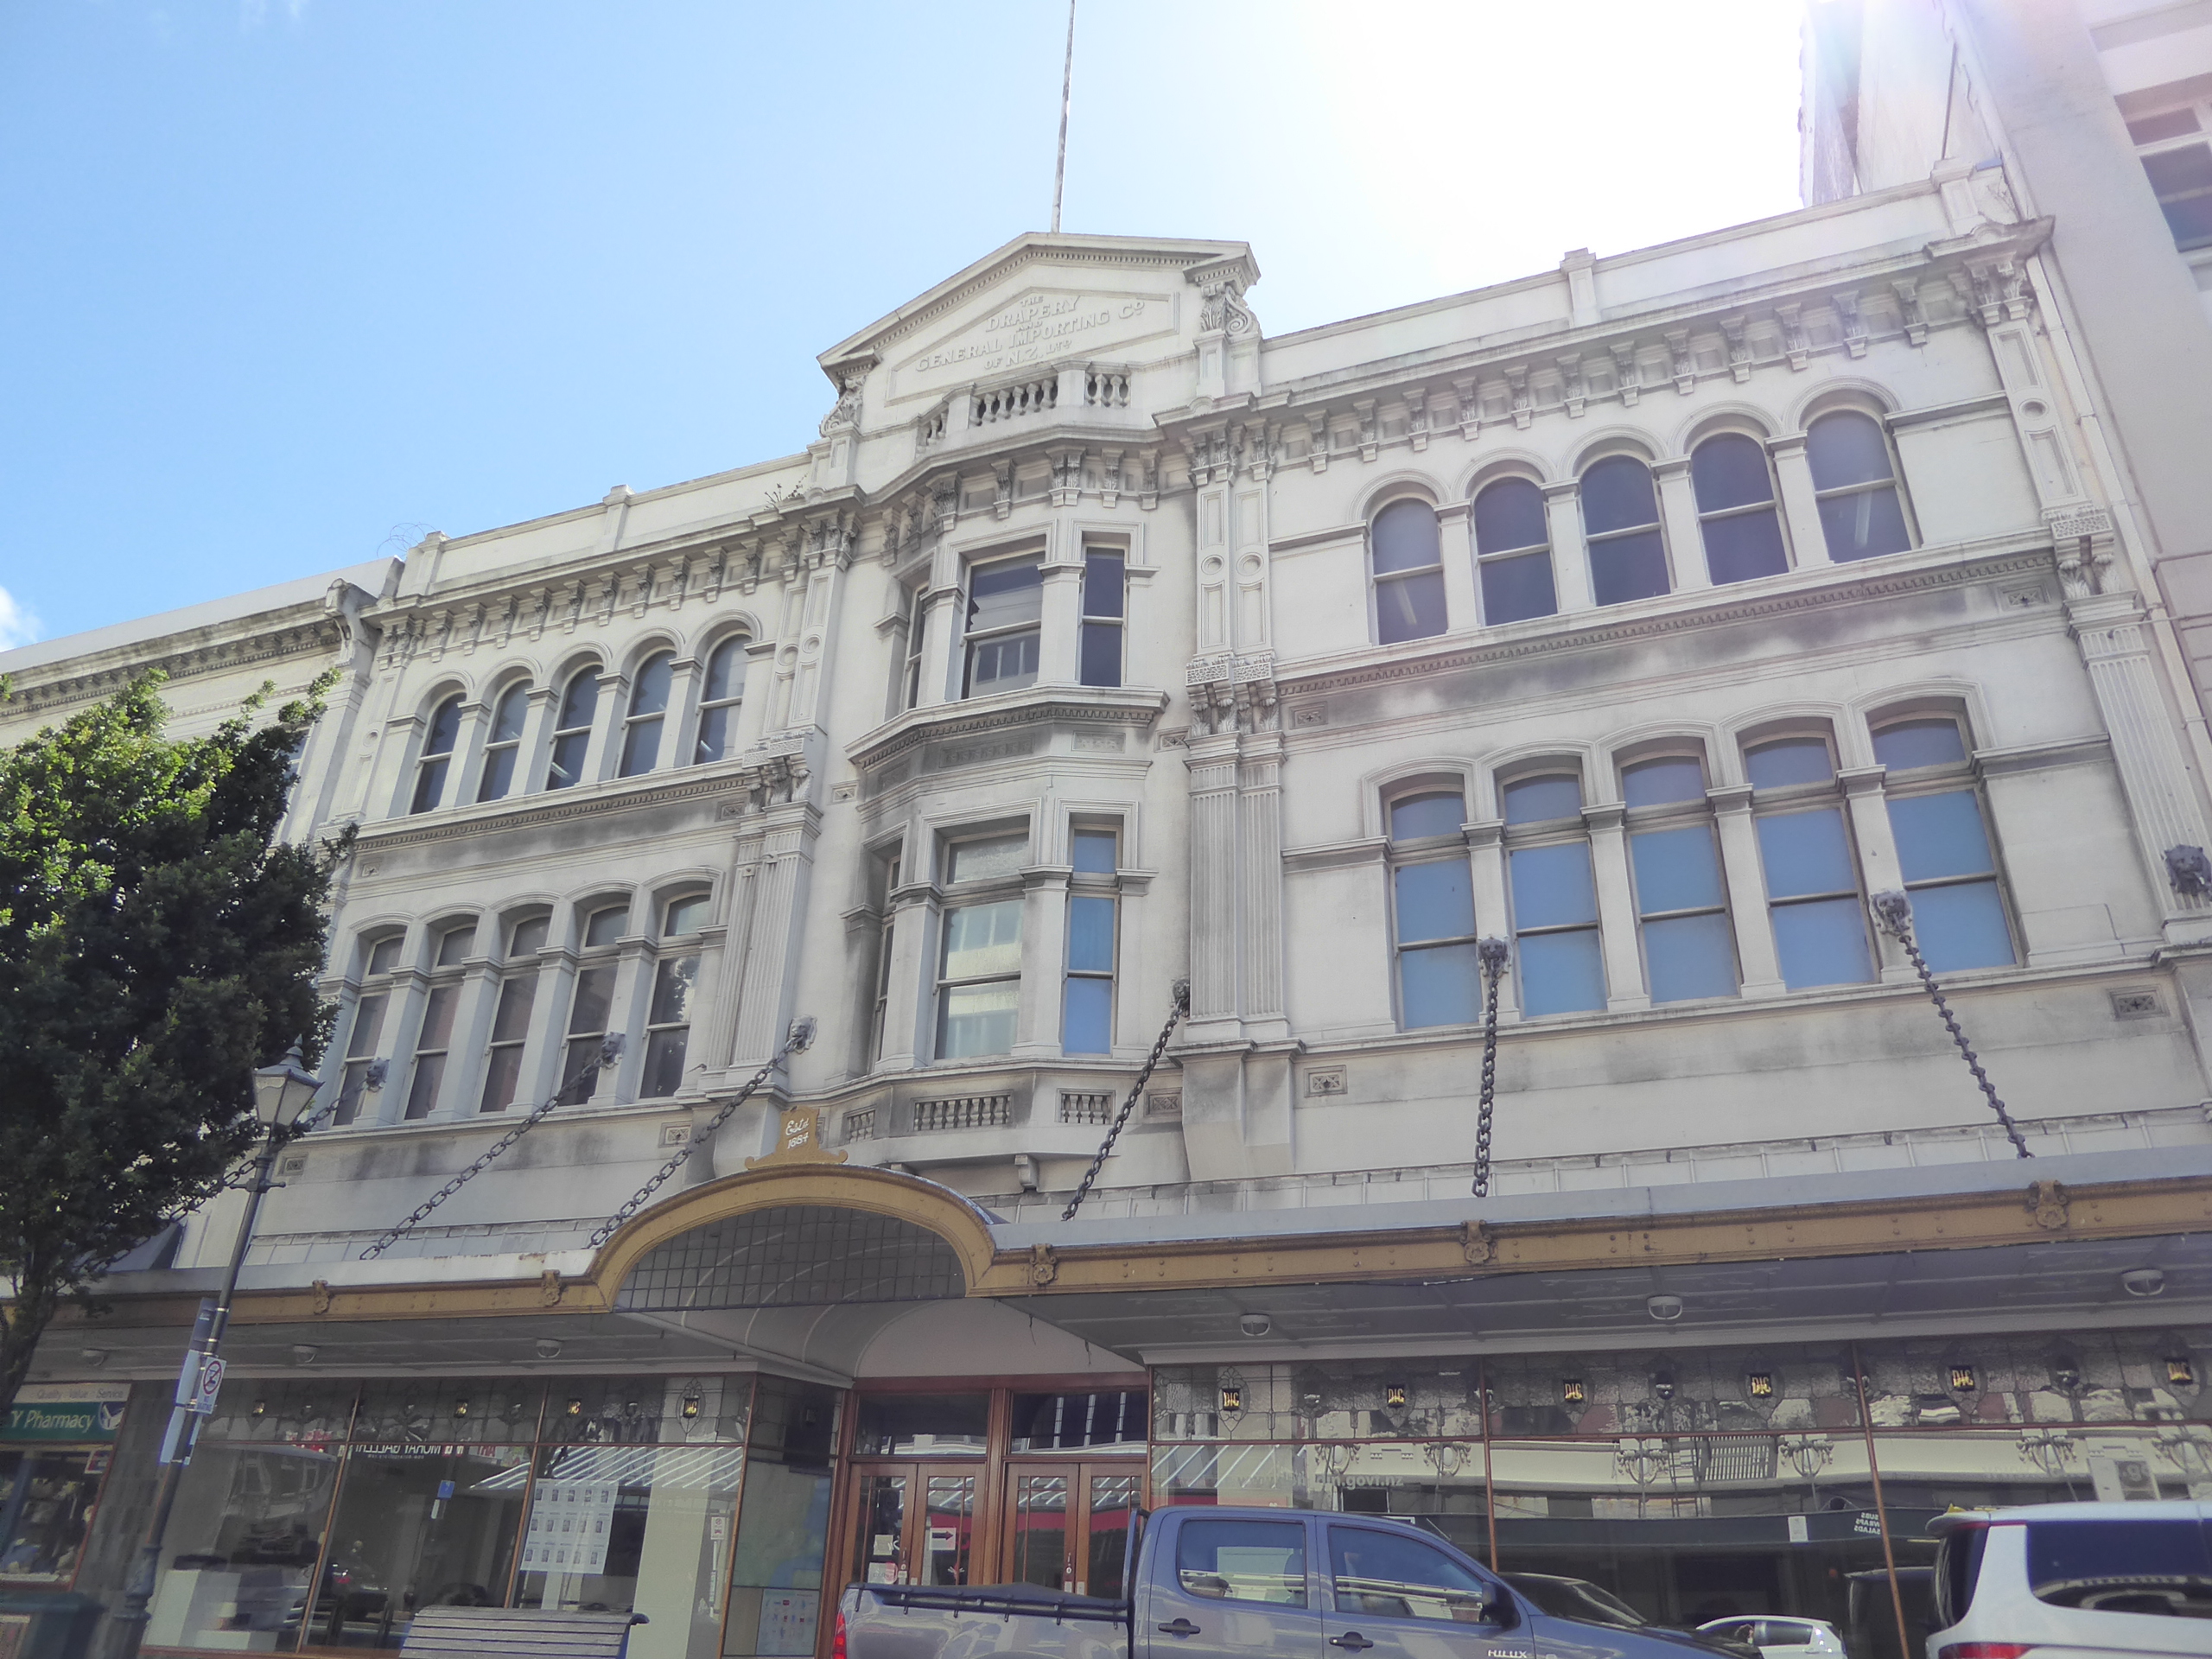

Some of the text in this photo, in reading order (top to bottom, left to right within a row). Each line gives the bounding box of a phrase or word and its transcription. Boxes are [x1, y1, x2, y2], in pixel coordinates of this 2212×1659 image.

[1020, 296, 1044, 307] THE
[985, 295, 1081, 333] DRAPERY
[1016, 321, 1043, 333] AND
[915, 338, 1002, 372] GENERAL
[1009, 310, 1110, 349] IMPORTING
[984, 358, 1003, 370] OF
[1224, 1391, 1240, 1407] DIC
[1388, 1389, 1406, 1403] DIC
[24, 1410, 96, 1433] Pharmacy
[1488, 1649, 1527, 1658] HILUX
